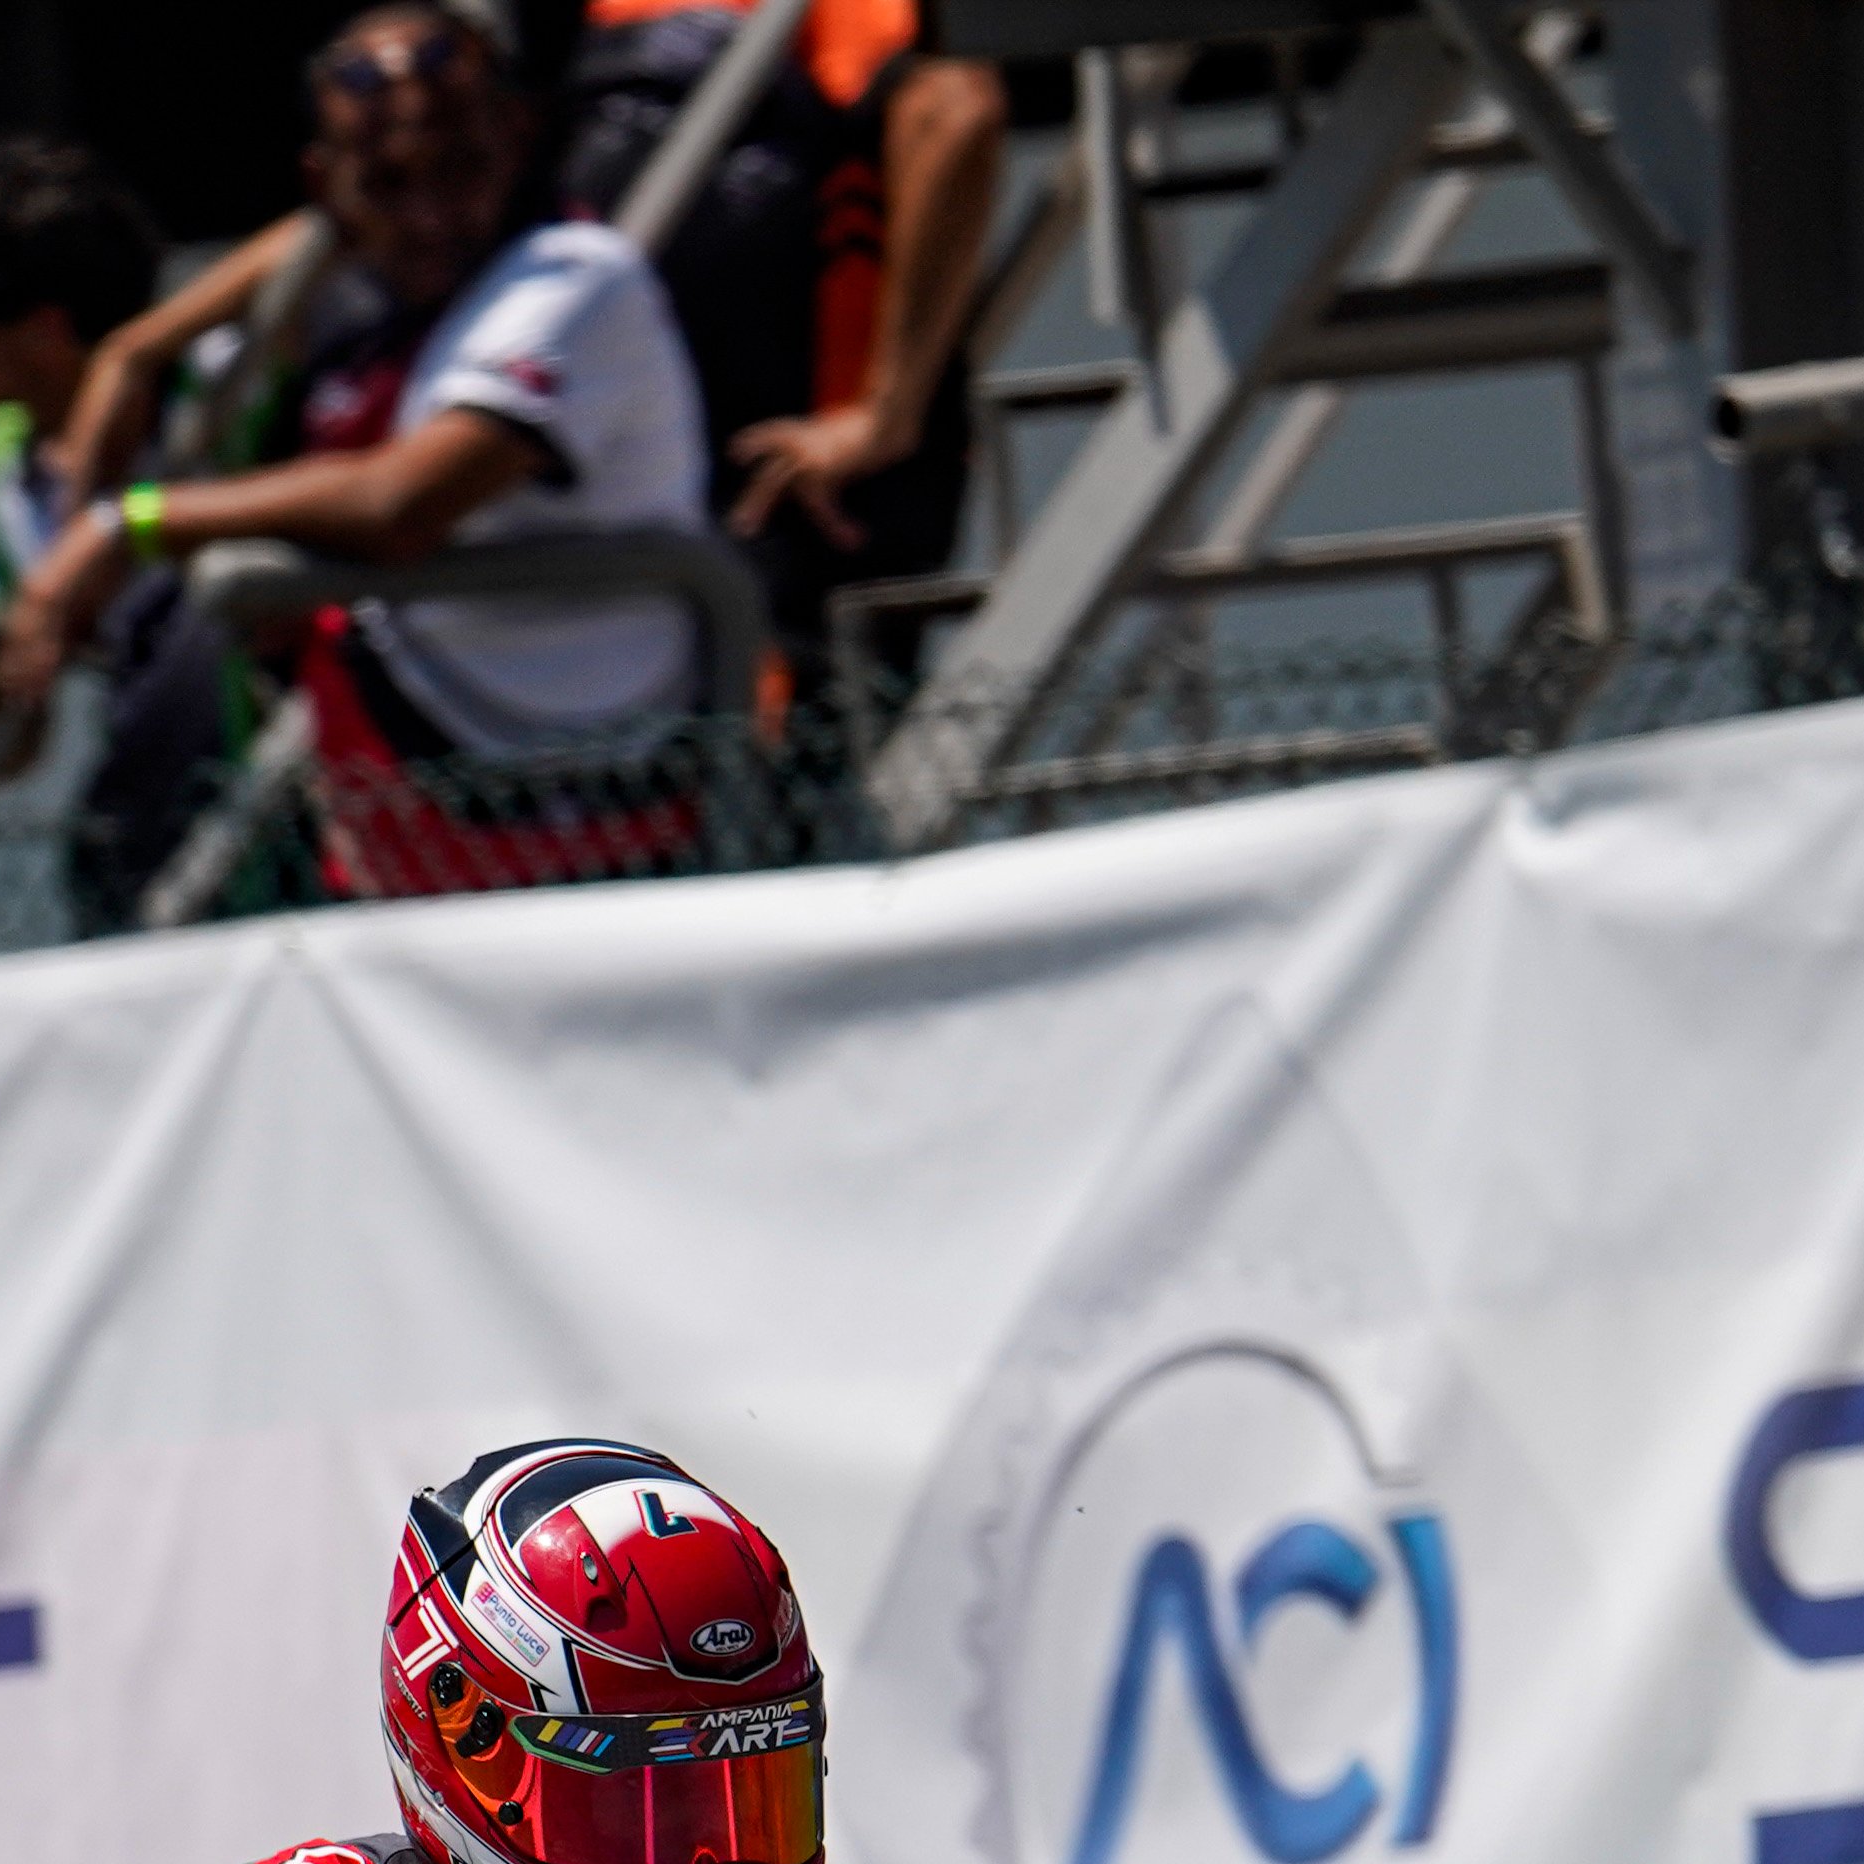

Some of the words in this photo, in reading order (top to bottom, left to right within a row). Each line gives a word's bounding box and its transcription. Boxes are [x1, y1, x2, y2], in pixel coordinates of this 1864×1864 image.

[489, 1595, 517, 1628] Punto
[516, 1625, 545, 1655] Luce
[700, 1625, 747, 1649] Arai
[683, 1702, 792, 1731] CAMPANIA
[687, 1719, 792, 1757] KART
